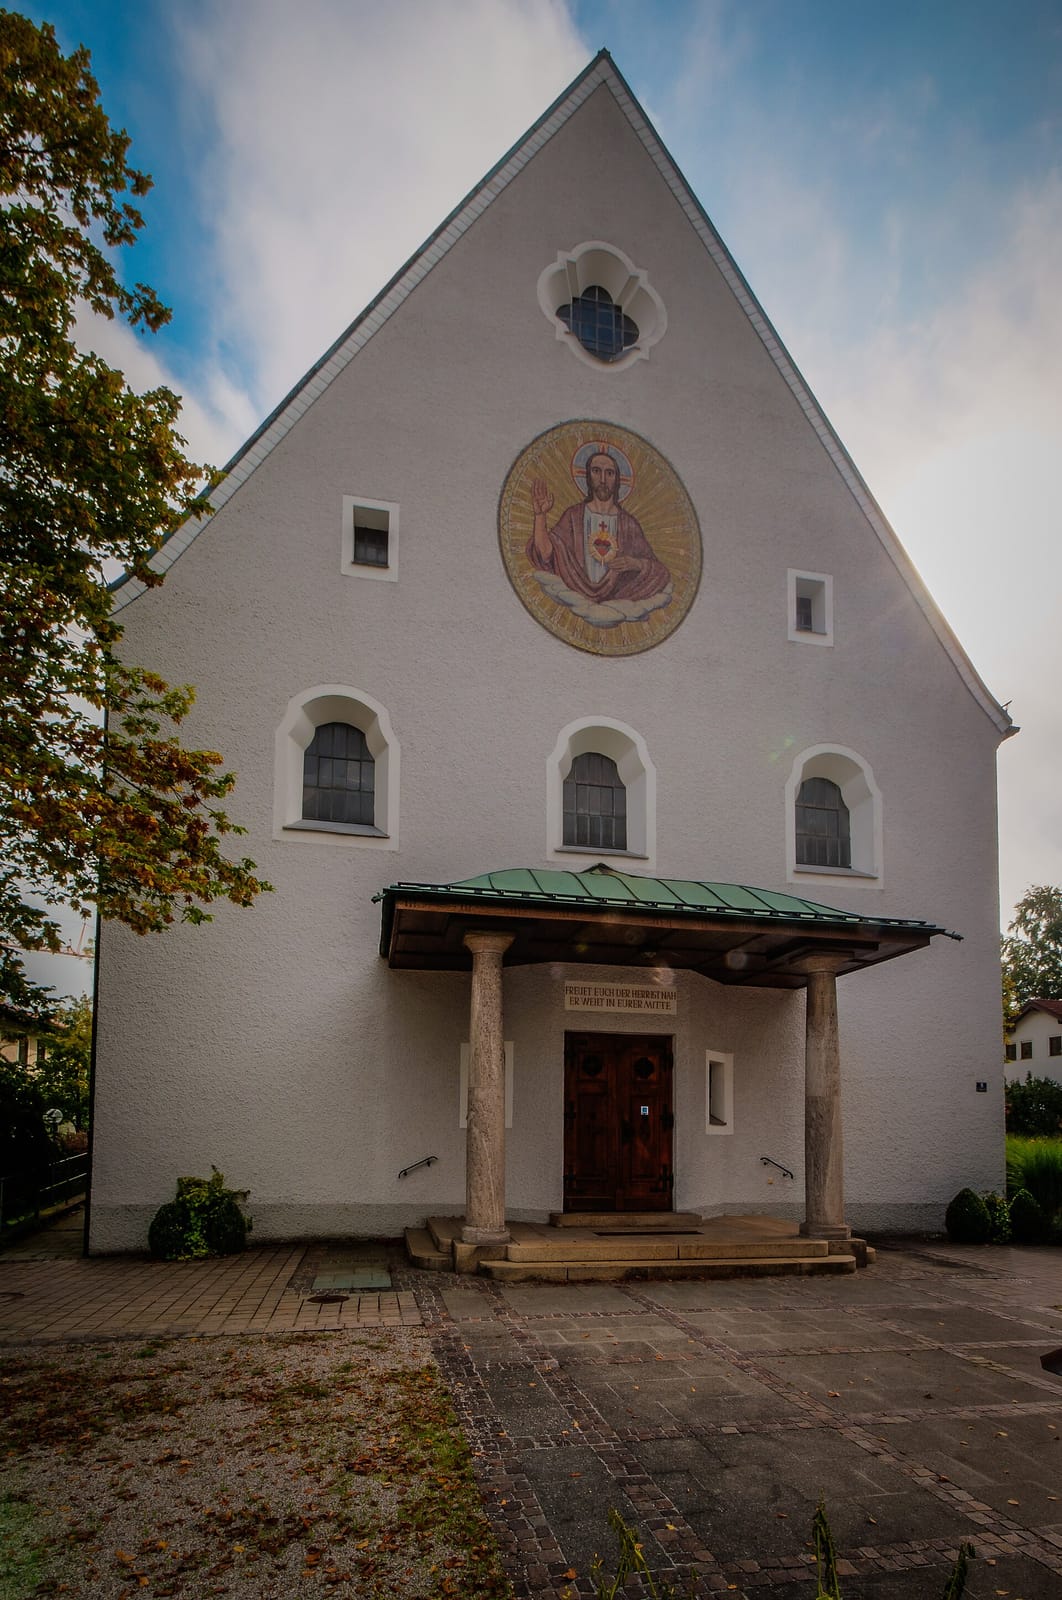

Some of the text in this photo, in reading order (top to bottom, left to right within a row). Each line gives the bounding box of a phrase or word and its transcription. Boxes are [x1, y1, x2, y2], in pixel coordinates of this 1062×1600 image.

[565, 985, 677, 1001] FREUET EUCH DER HERR IST NAH
[569, 996, 579, 1005] ER
[606, 998, 615, 1007] IN
[617, 999, 642, 1009] EURER
